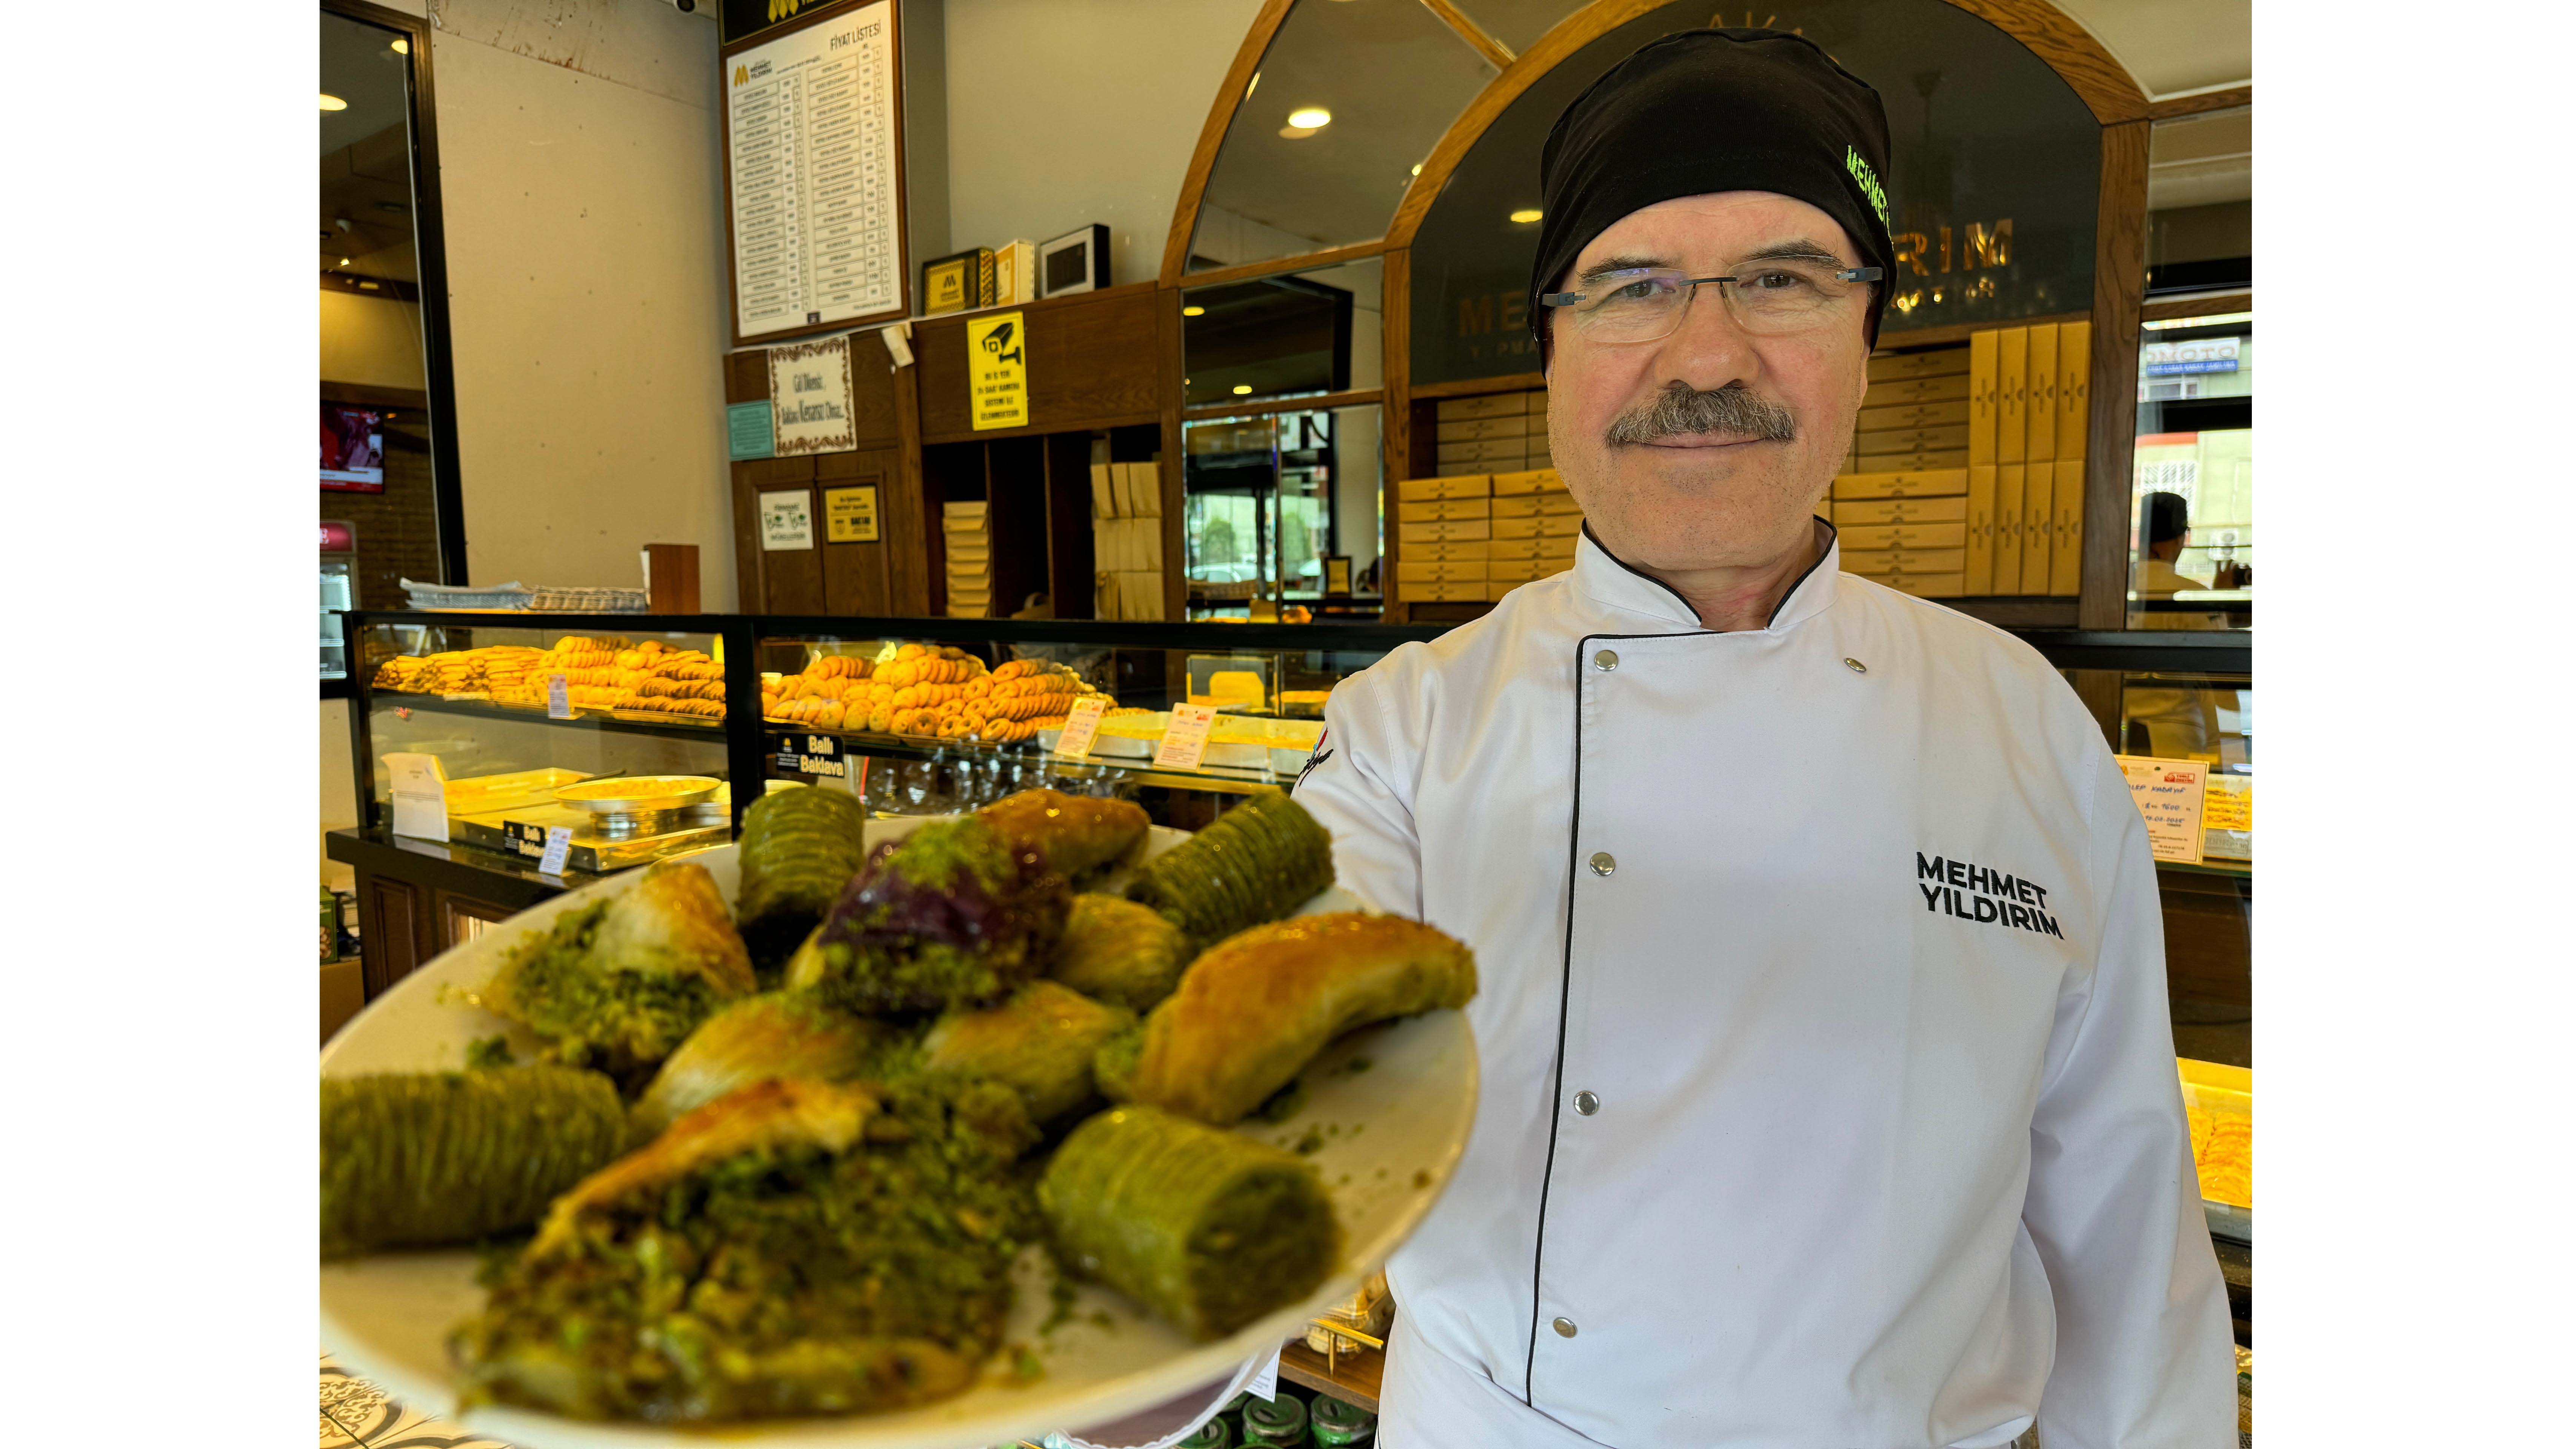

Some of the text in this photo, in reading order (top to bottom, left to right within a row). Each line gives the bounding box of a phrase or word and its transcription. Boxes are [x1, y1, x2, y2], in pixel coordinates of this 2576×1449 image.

[852, 20, 882, 44] LİSTESİ
[750, 60, 771, 72] MEHMET
[808, 735, 834, 755] Ballı
[800, 754, 844, 777] Baklava
[1916, 851, 2047, 909] MEHMET
[1919, 883, 2065, 940] YILDIRIM
